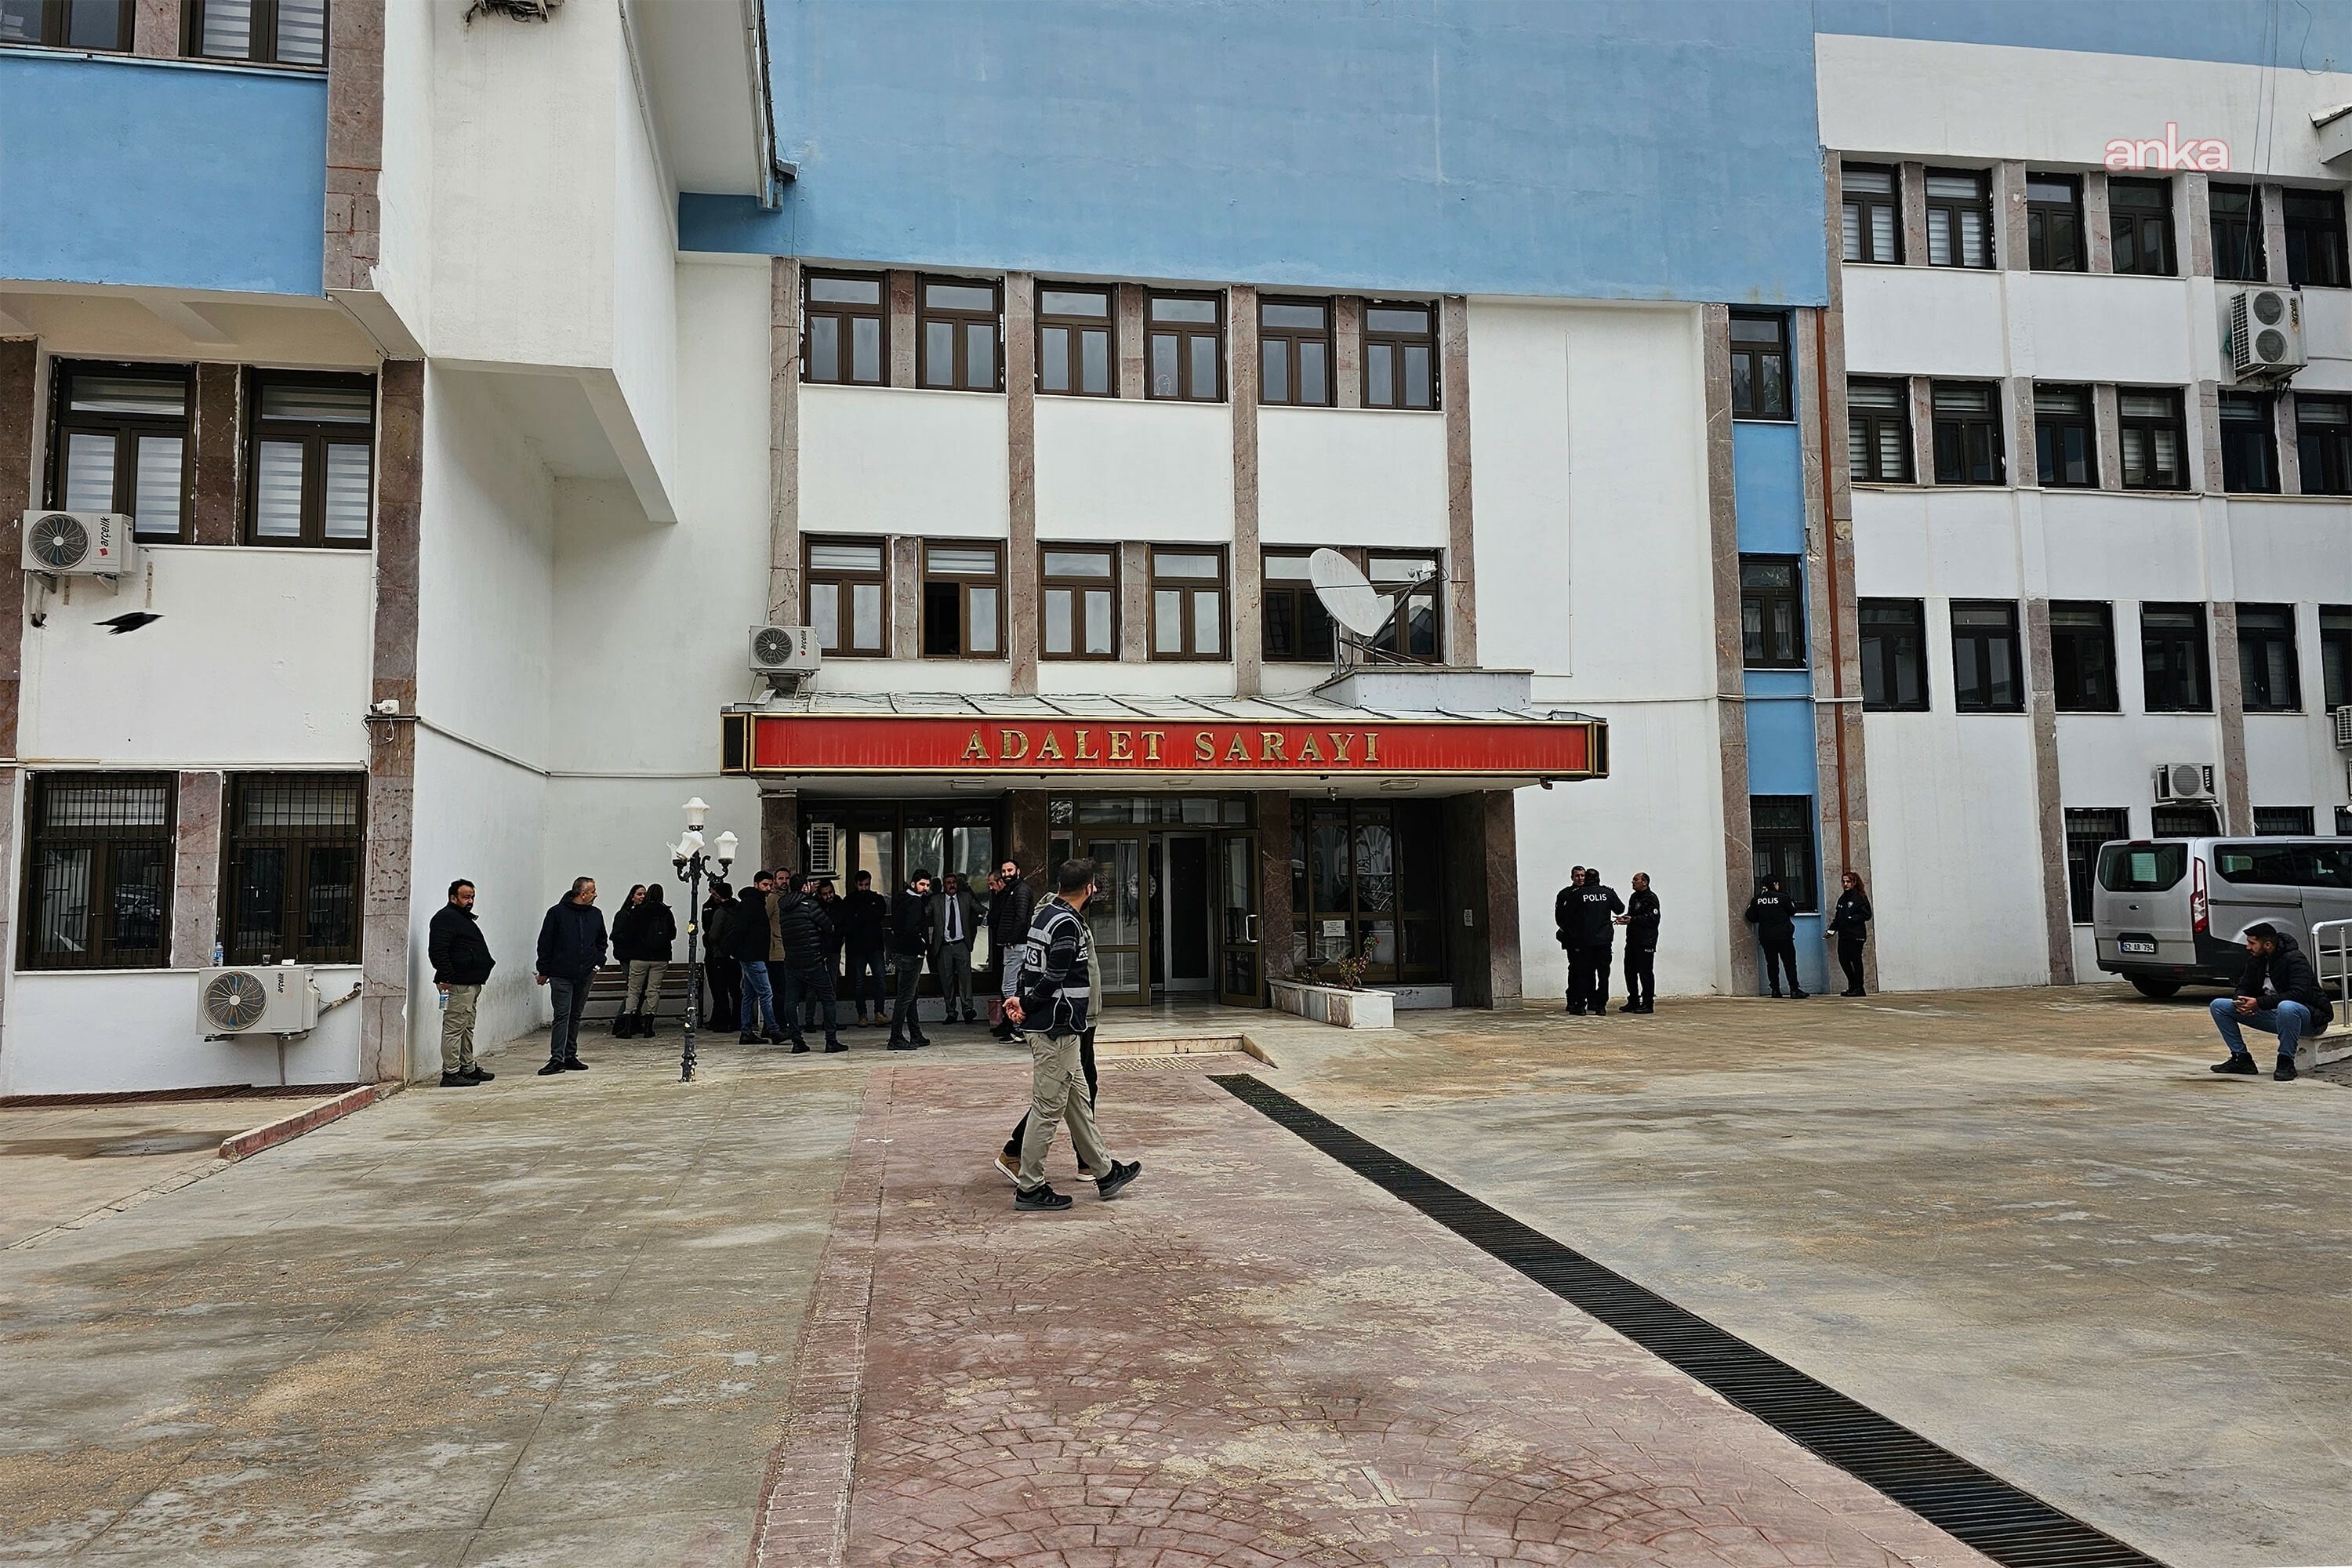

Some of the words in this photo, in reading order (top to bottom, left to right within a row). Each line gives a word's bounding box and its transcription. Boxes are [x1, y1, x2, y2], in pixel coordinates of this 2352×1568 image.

[100, 516, 111, 546] arçelik
[961, 729, 1166, 760] ADALET
[1195, 731, 1379, 762] SARAYI
